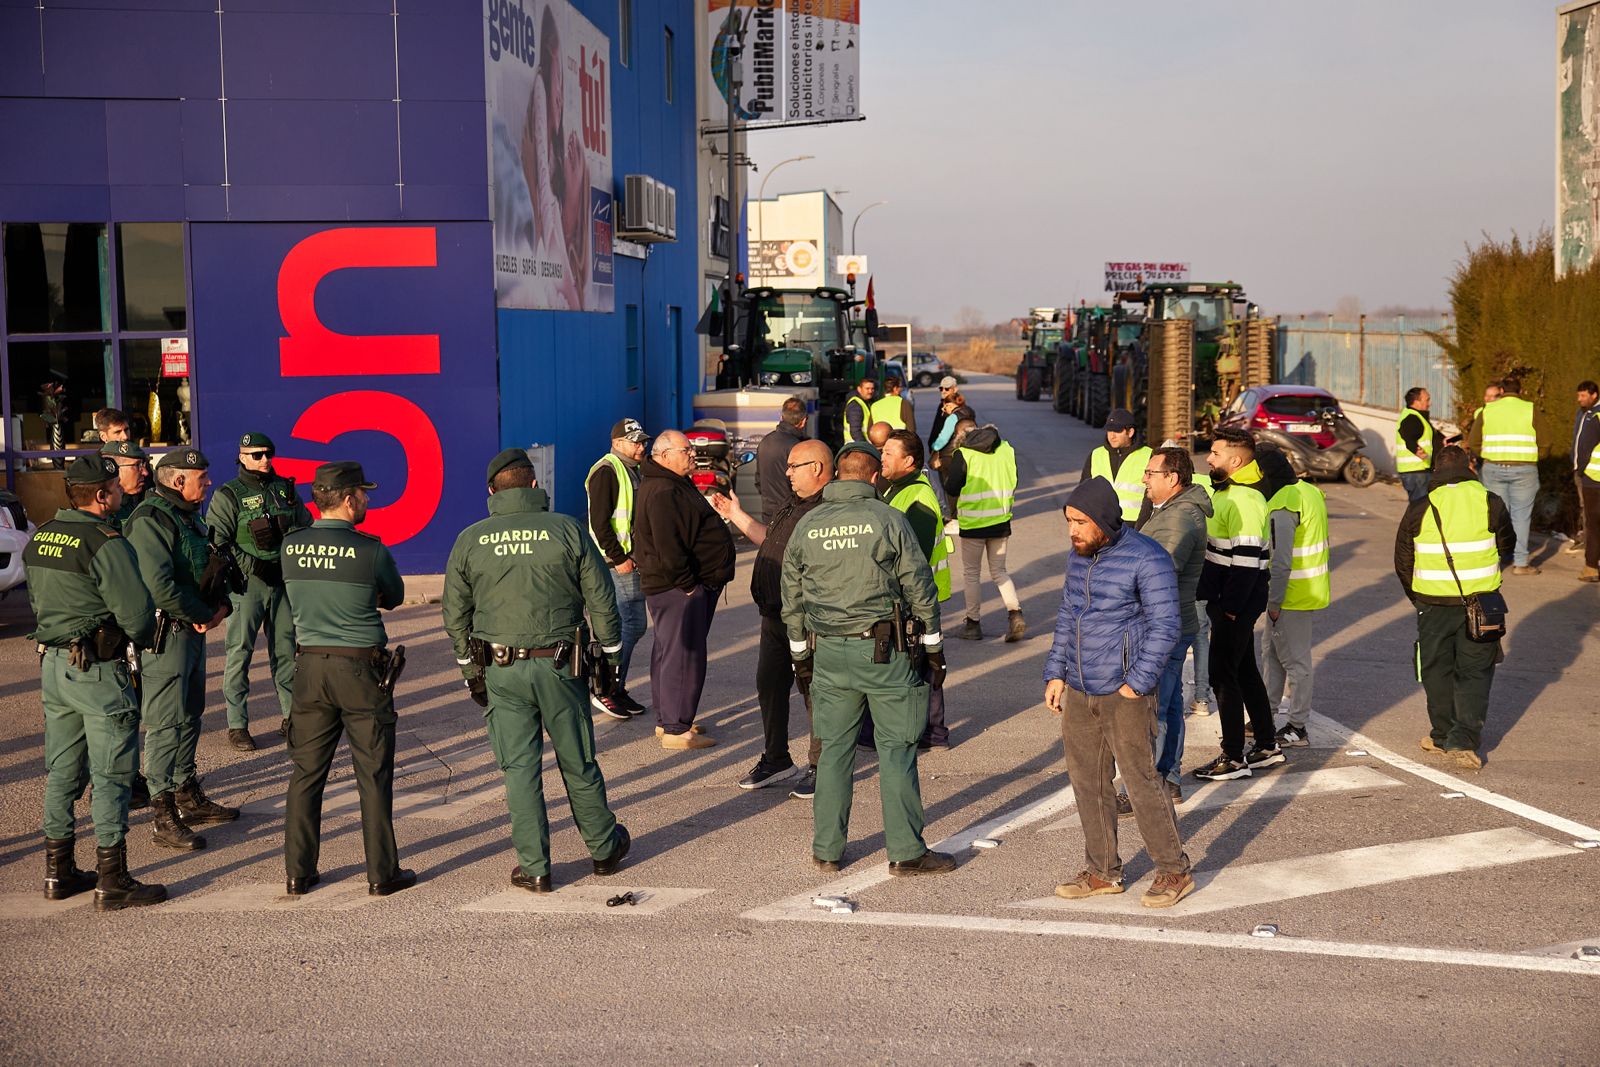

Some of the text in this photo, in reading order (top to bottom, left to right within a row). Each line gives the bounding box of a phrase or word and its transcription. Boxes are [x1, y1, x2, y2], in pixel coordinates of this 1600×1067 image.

[488, 0, 535, 68] gente
[802, 32, 815, 118] publicitarias
[789, 51, 800, 118] Soluciones
[579, 44, 606, 157] tú!
[522, 256, 536, 276] SOFÁS
[541, 261, 562, 278] DESCANSO
[1108, 262, 1142, 271] VEGAS
[1145, 271, 1182, 280] JUSTOS
[479, 530, 550, 544] GUARDIA
[807, 524, 874, 539] GUARDIA
[33, 532, 81, 548] GUARDIA
[823, 537, 859, 550] CIVIL
[38, 544, 63, 558] CIVIL
[286, 544, 356, 558] GUARDIA
[494, 543, 533, 556] CIVIL
[298, 557, 336, 569] CIVIL
